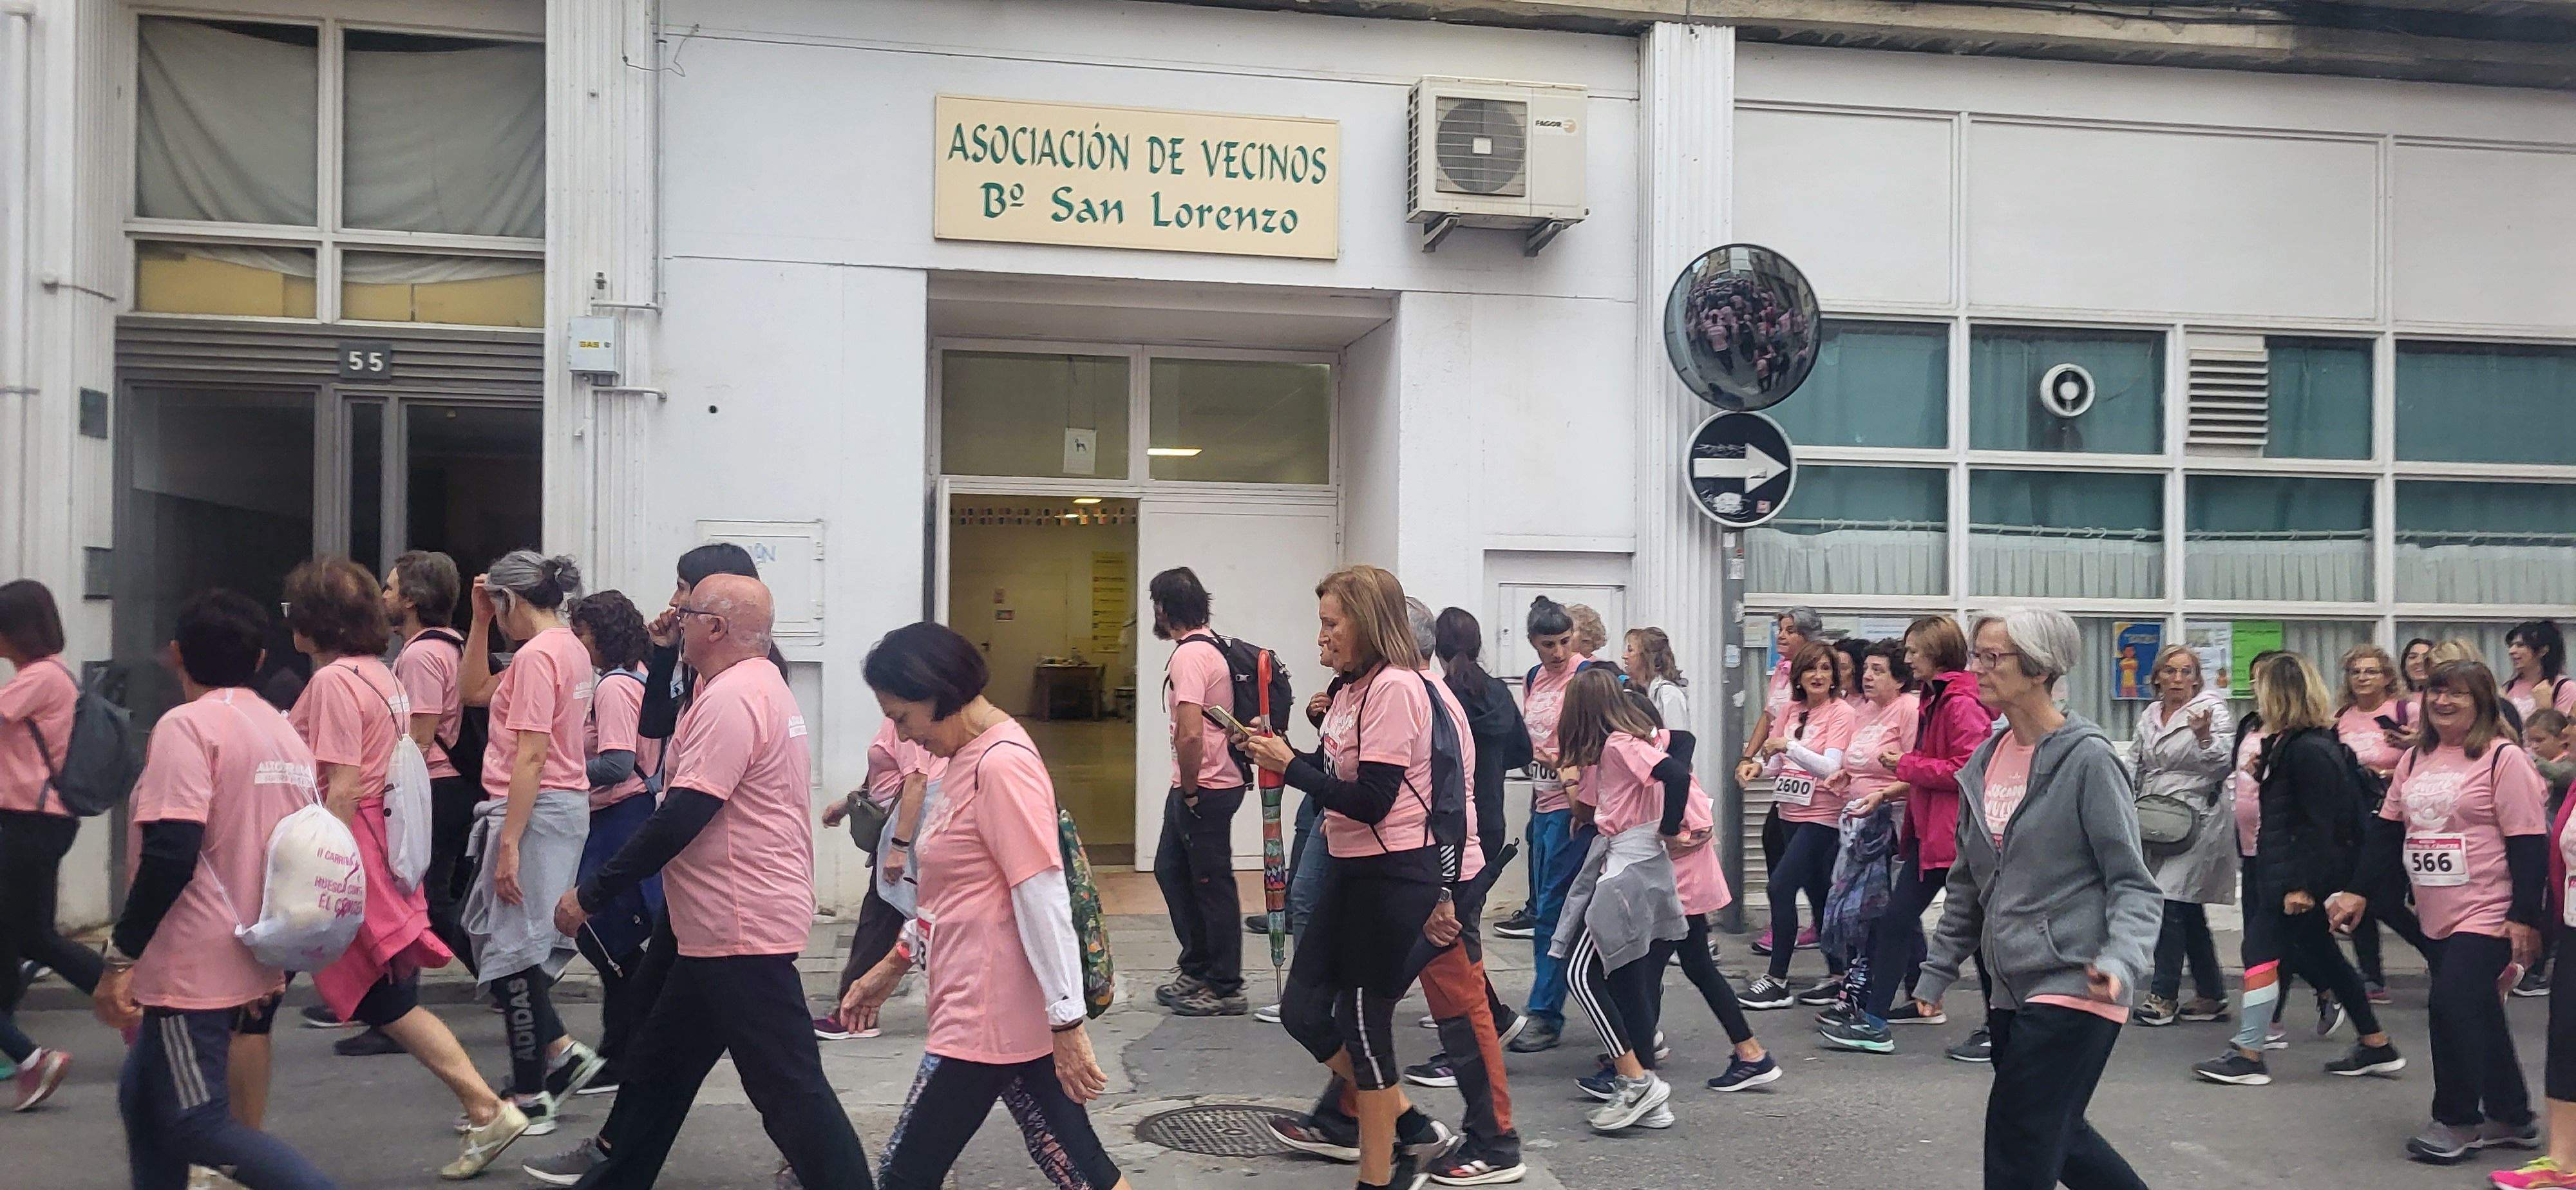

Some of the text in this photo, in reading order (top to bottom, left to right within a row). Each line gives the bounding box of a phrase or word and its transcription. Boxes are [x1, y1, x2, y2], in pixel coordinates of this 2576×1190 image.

[947, 122, 1327, 185] ASOCIACIÓN DE VECINOS
[980, 182, 1299, 234] Bº San Lorenzo
[350, 351, 383, 372] 55
[1777, 778, 1810, 795] 2600
[2412, 853, 2452, 872] 566
[507, 978, 537, 1061] ADIDAS
